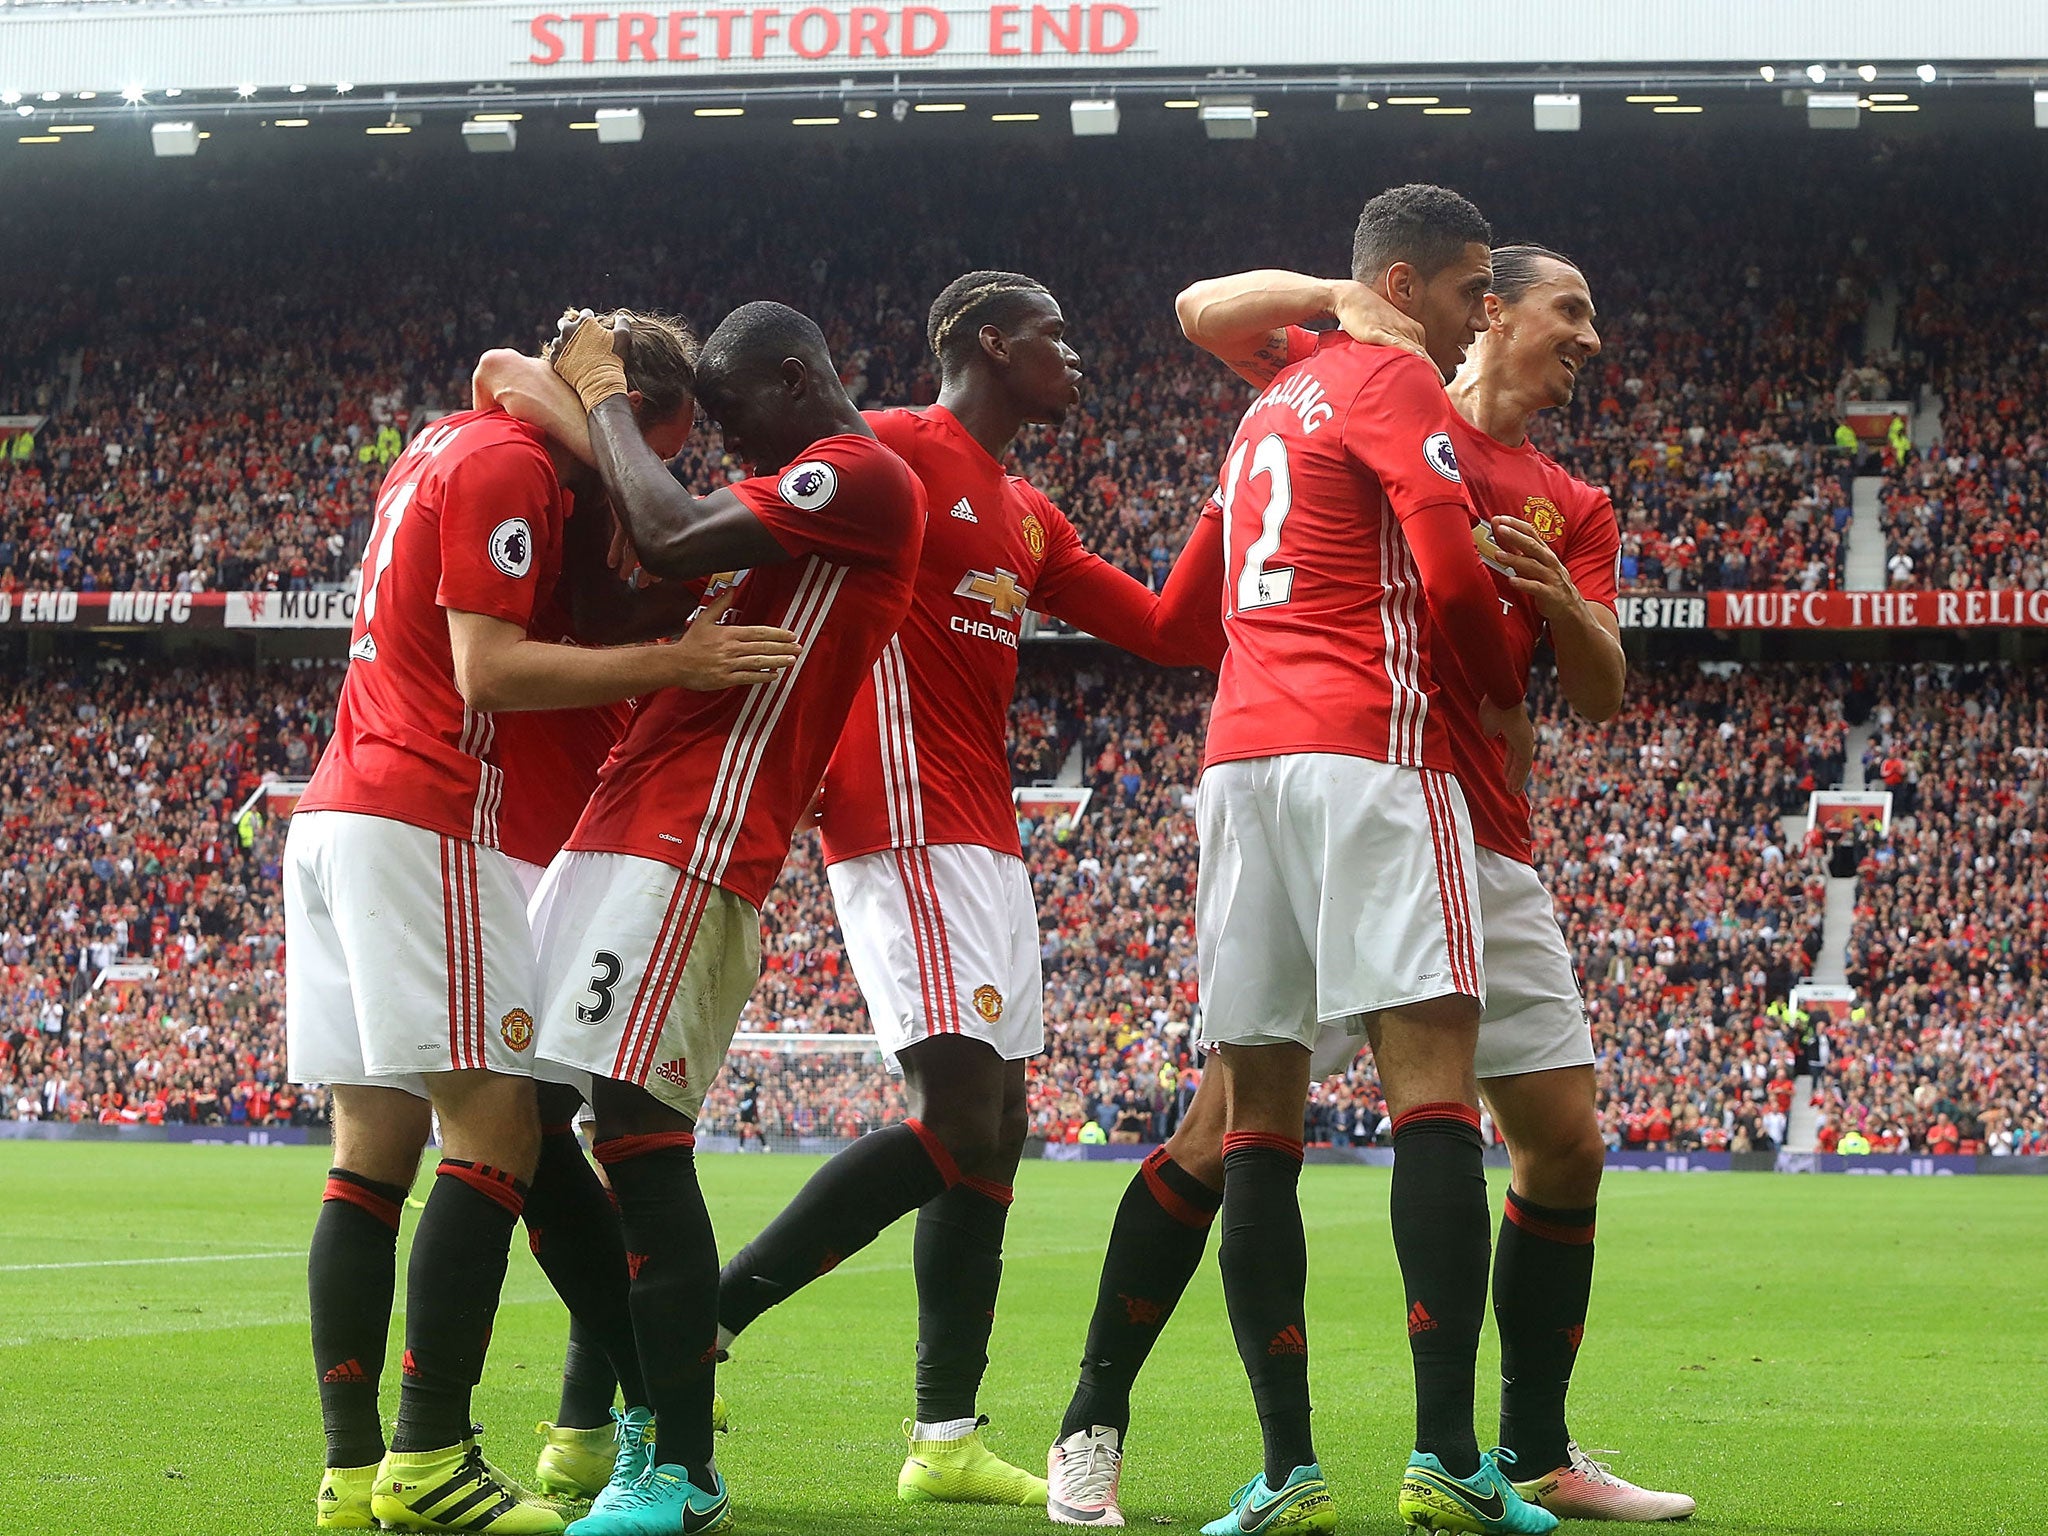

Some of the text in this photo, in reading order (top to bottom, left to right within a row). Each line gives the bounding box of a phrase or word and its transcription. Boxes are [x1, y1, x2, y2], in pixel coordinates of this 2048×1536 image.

[529, 2, 1140, 65] STRETFORD END
[950, 509, 979, 524] adidas
[1222, 433, 1295, 621] 12
[20, 591, 78, 622] END
[108, 591, 192, 623] MUFC
[1725, 591, 1828, 627] MUFC
[1845, 591, 1919, 627] THE
[658, 832, 683, 844] adizero
[575, 949, 624, 1026] 3
[656, 1066, 689, 1089] adidas
